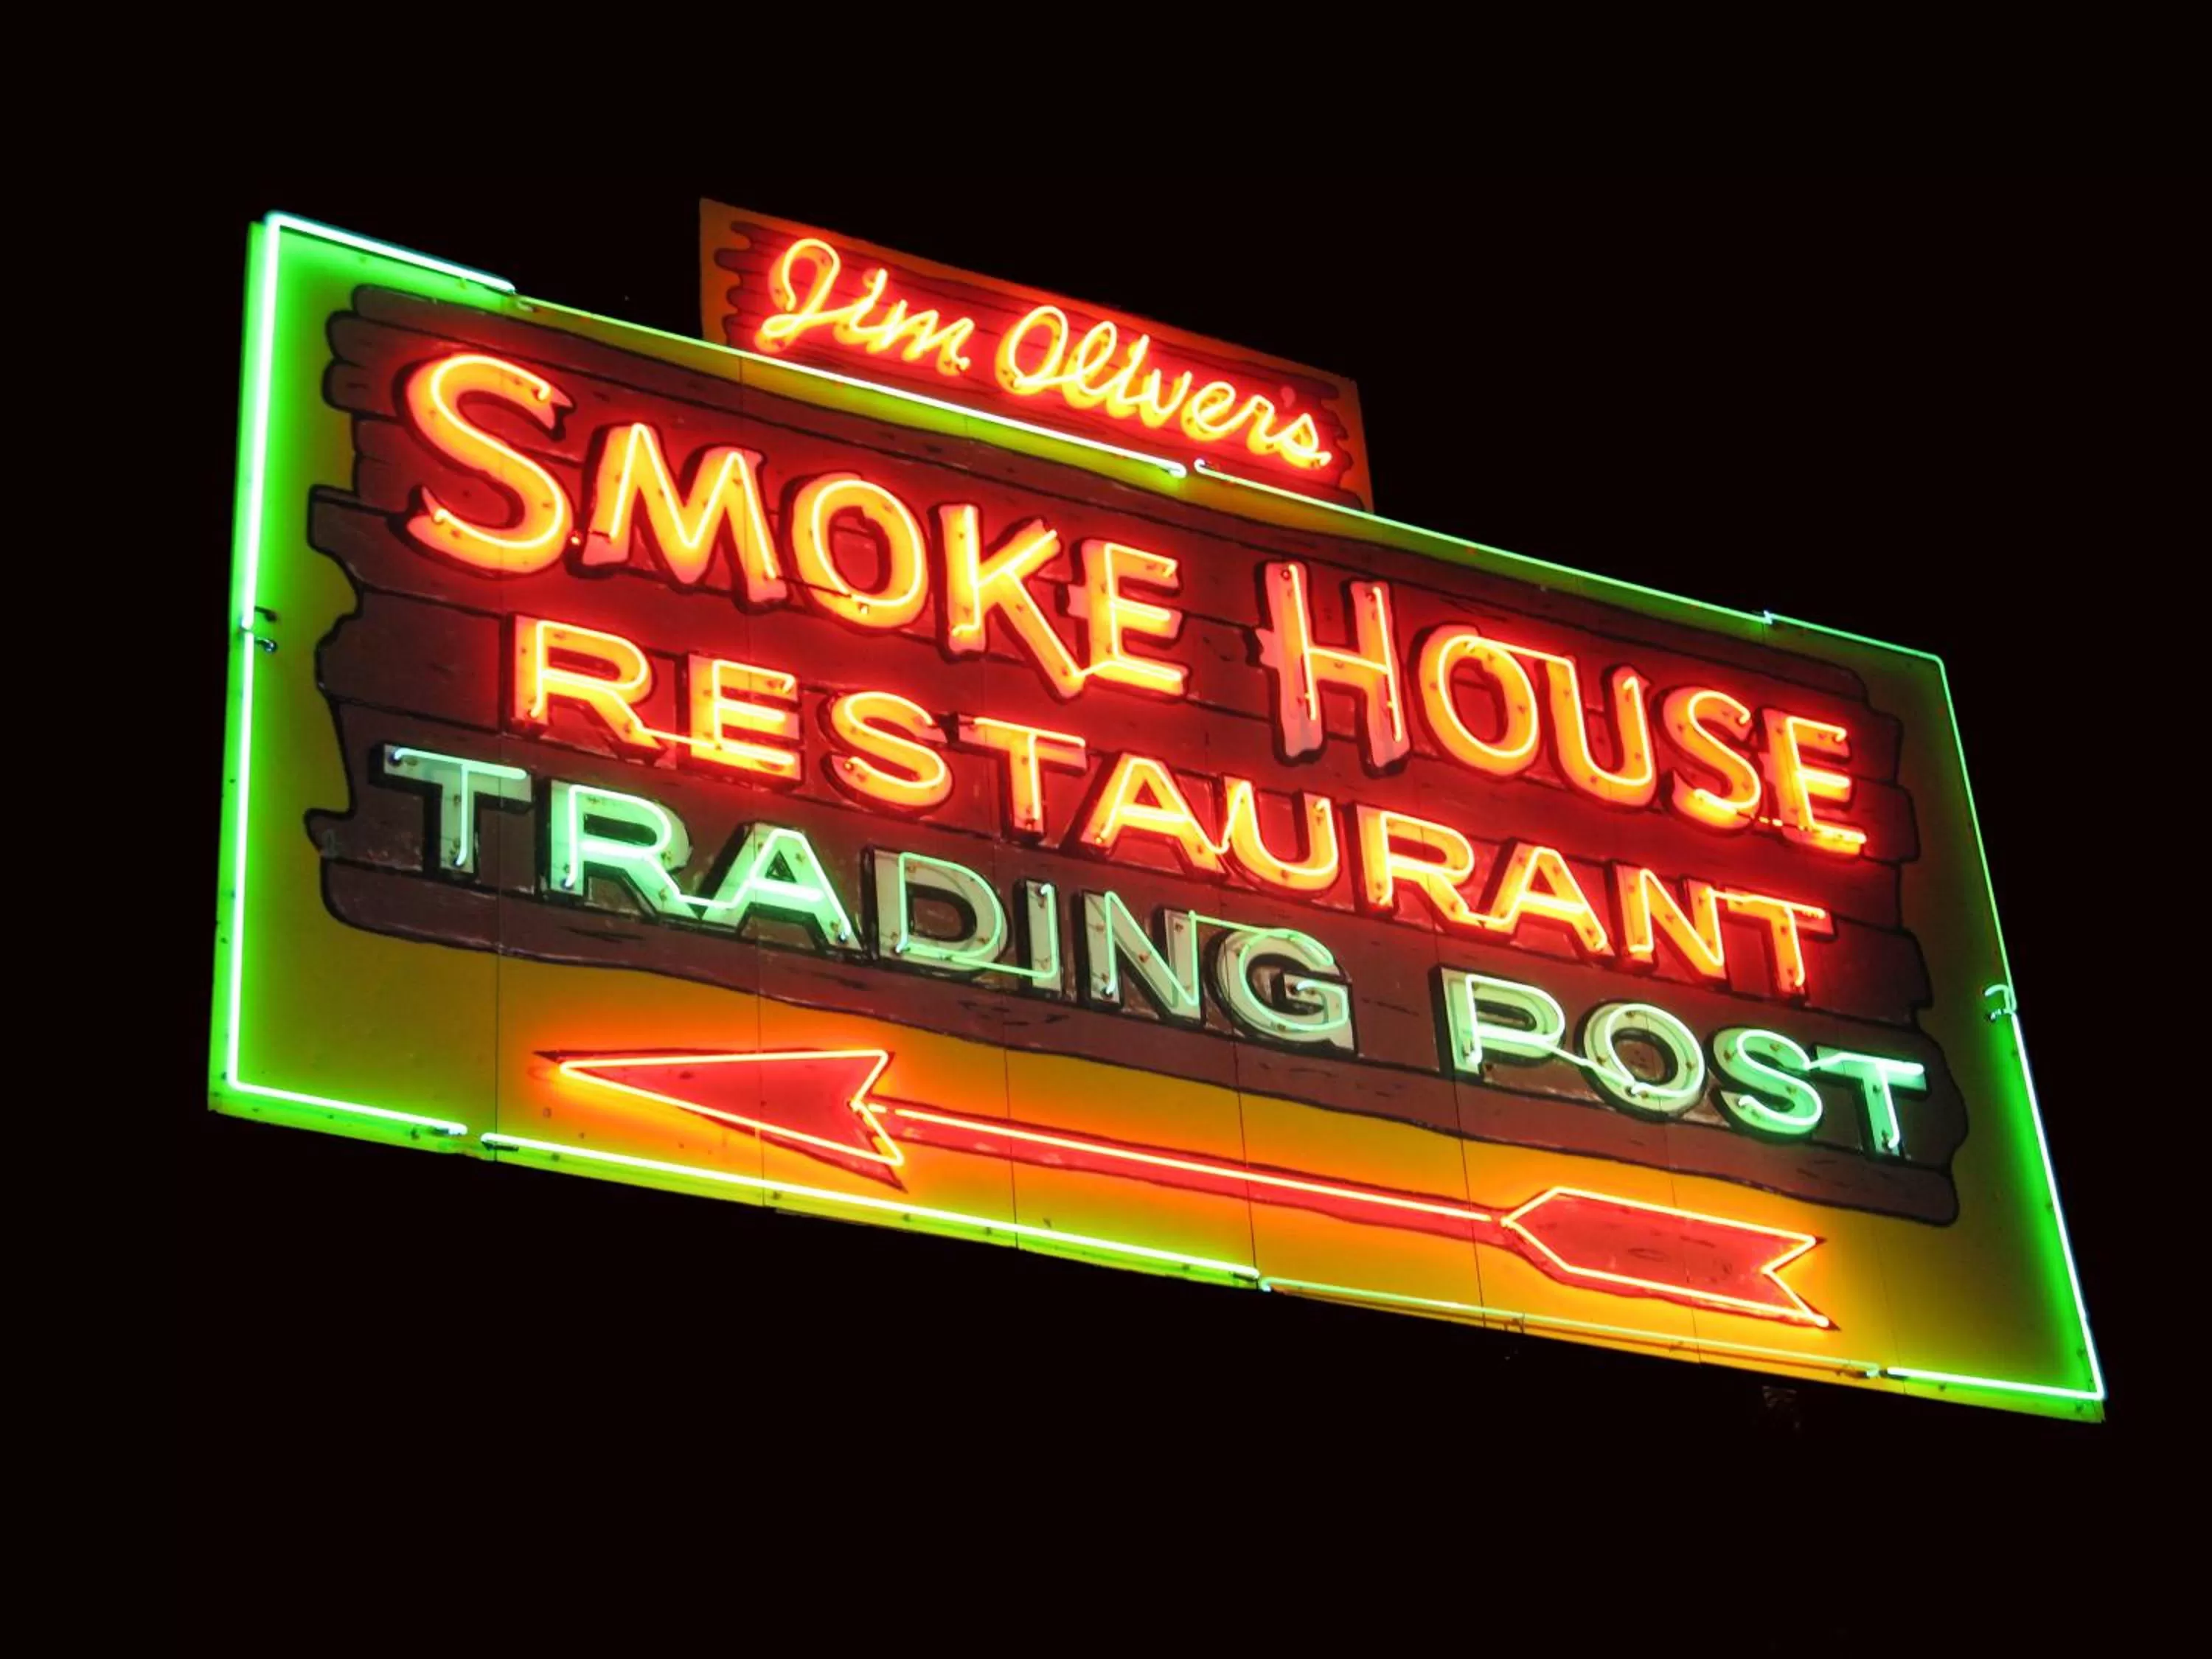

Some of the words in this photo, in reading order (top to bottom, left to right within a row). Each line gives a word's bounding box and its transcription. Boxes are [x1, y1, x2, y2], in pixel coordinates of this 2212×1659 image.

[754, 237, 975, 375] Jim
[994, 305, 1335, 469] Oliver's
[405, 352, 1189, 697] SMOKE
[1253, 559, 1868, 857] HOUSE
[383, 742, 1355, 1053] TRADING
[1439, 967, 1927, 1156] POST
[509, 613, 1833, 997] RESTAURANT
